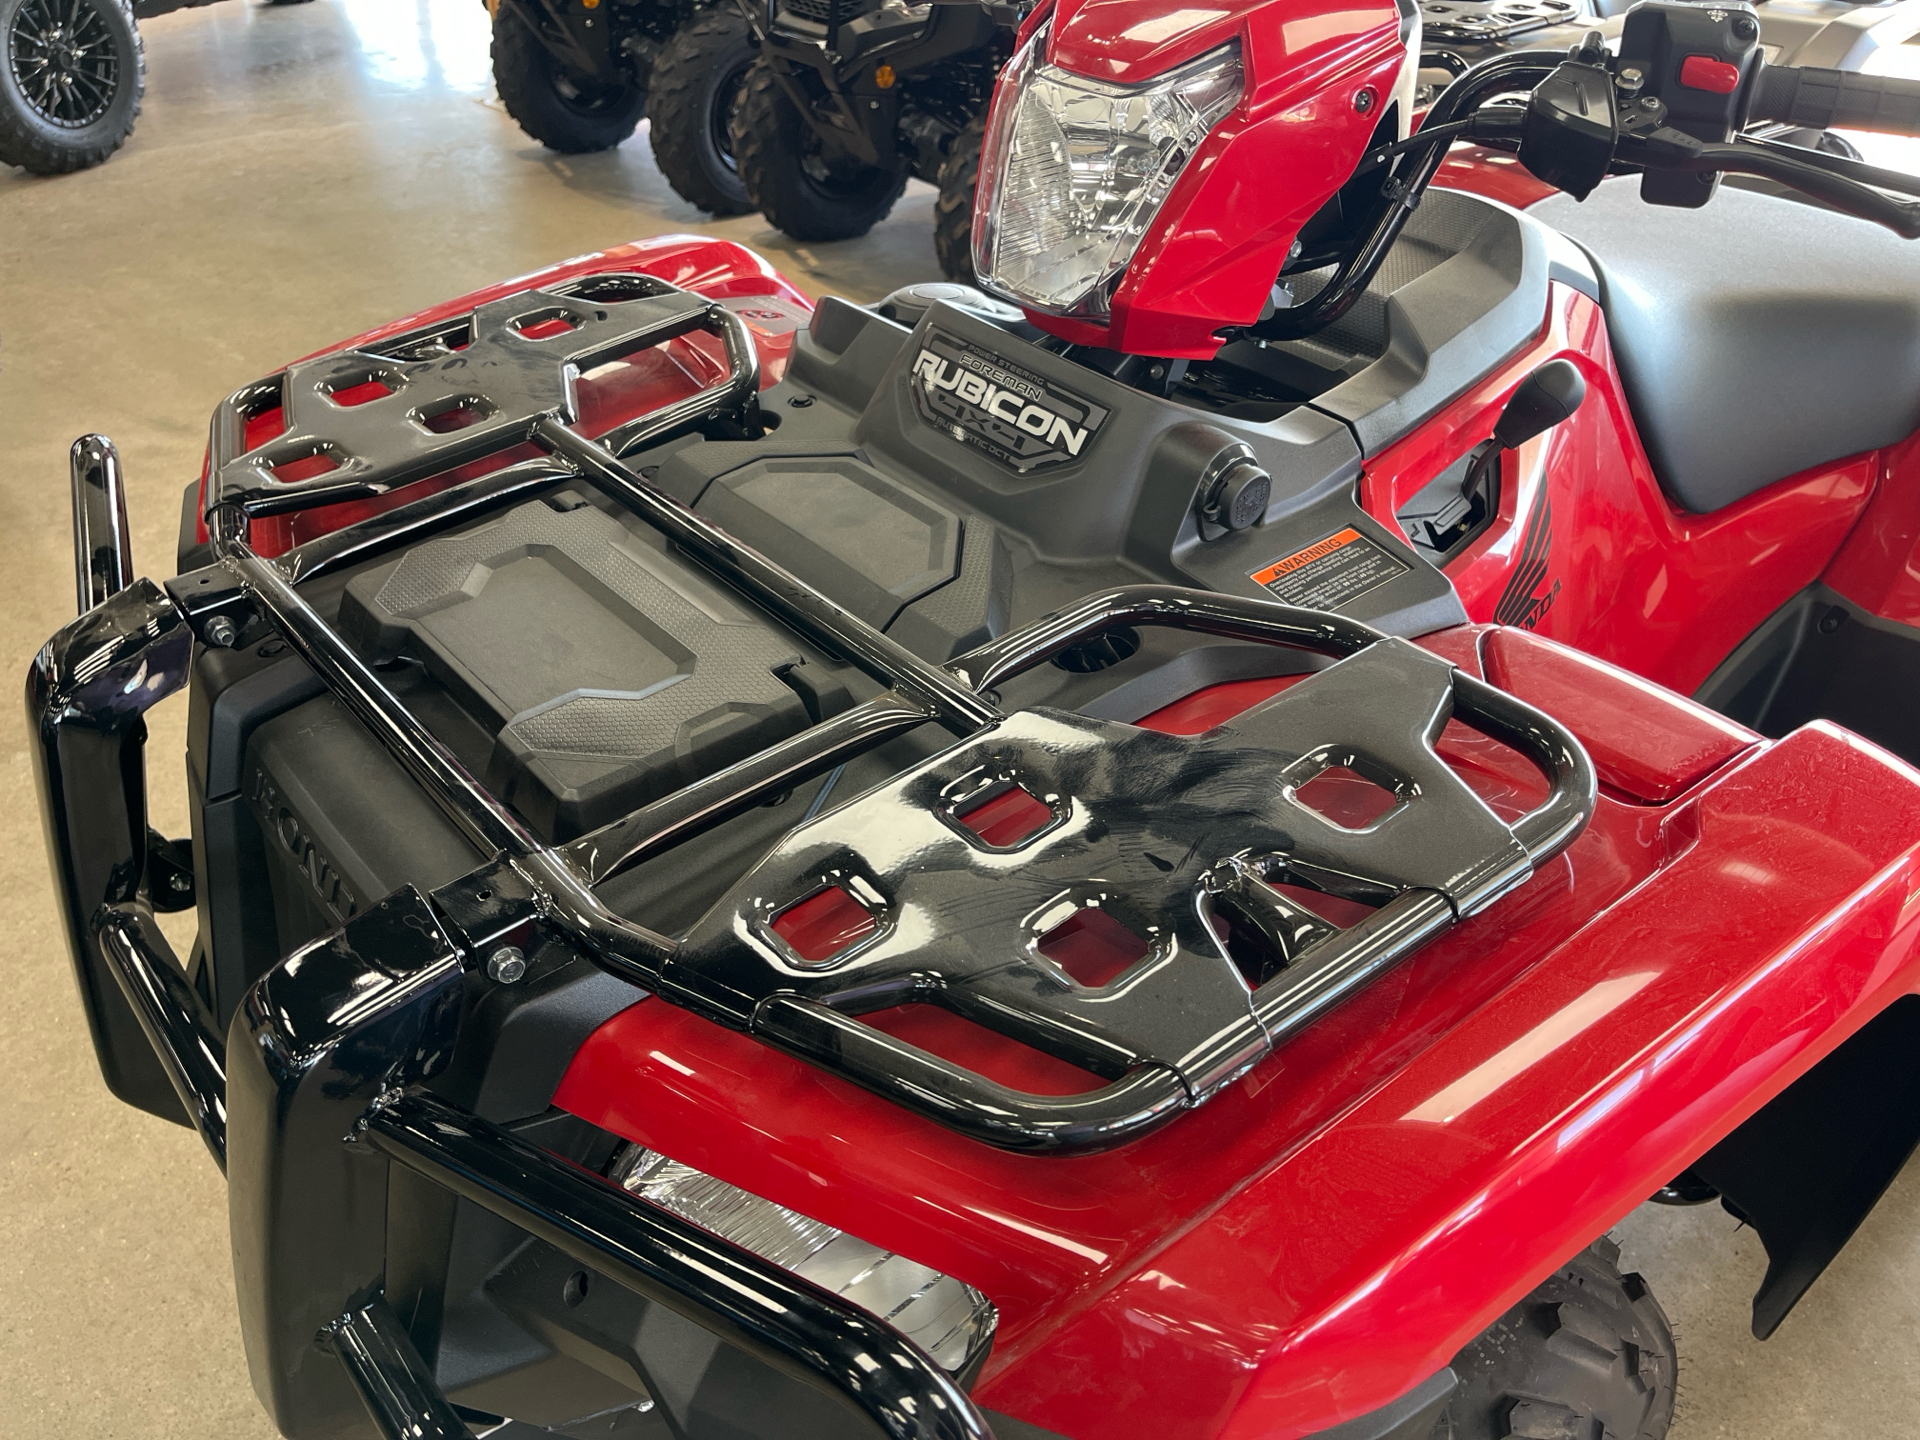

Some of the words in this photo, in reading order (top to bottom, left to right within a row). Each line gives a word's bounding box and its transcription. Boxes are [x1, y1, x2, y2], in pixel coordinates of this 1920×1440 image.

[959, 354, 1043, 401] FOREMAN
[968, 344, 997, 363] POWER
[997, 357, 1045, 385] STEERING
[912, 349, 1089, 456] RUBICON
[988, 446, 1009, 460] DCT
[1279, 538, 1342, 572] WARNING
[1519, 577, 1562, 630] NDA
[252, 768, 358, 924] HOND
